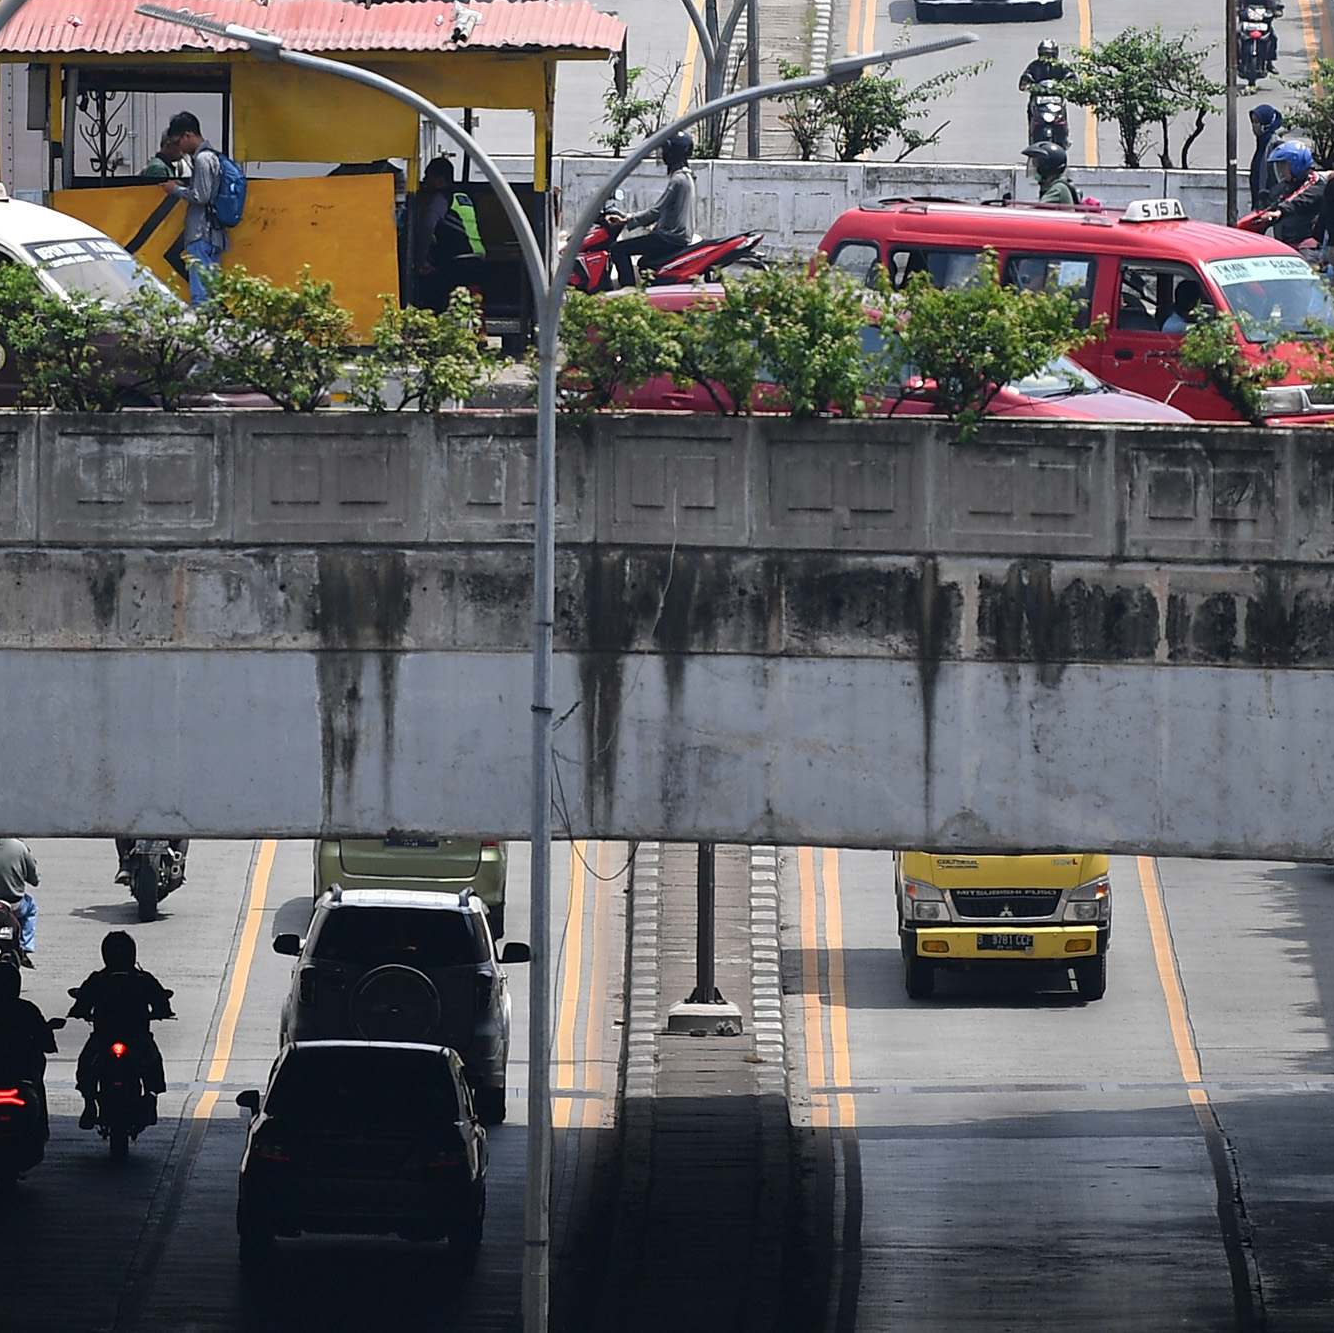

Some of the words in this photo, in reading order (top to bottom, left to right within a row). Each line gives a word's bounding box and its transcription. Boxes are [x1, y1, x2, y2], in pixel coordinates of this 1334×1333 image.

[1142, 203, 1151, 217] S
[1155, 201, 1169, 216] 15
[1173, 201, 1182, 216] A
[978, 935, 984, 946] B
[992, 934, 1013, 946] 9781
[1016, 935, 1032, 947] CCF
